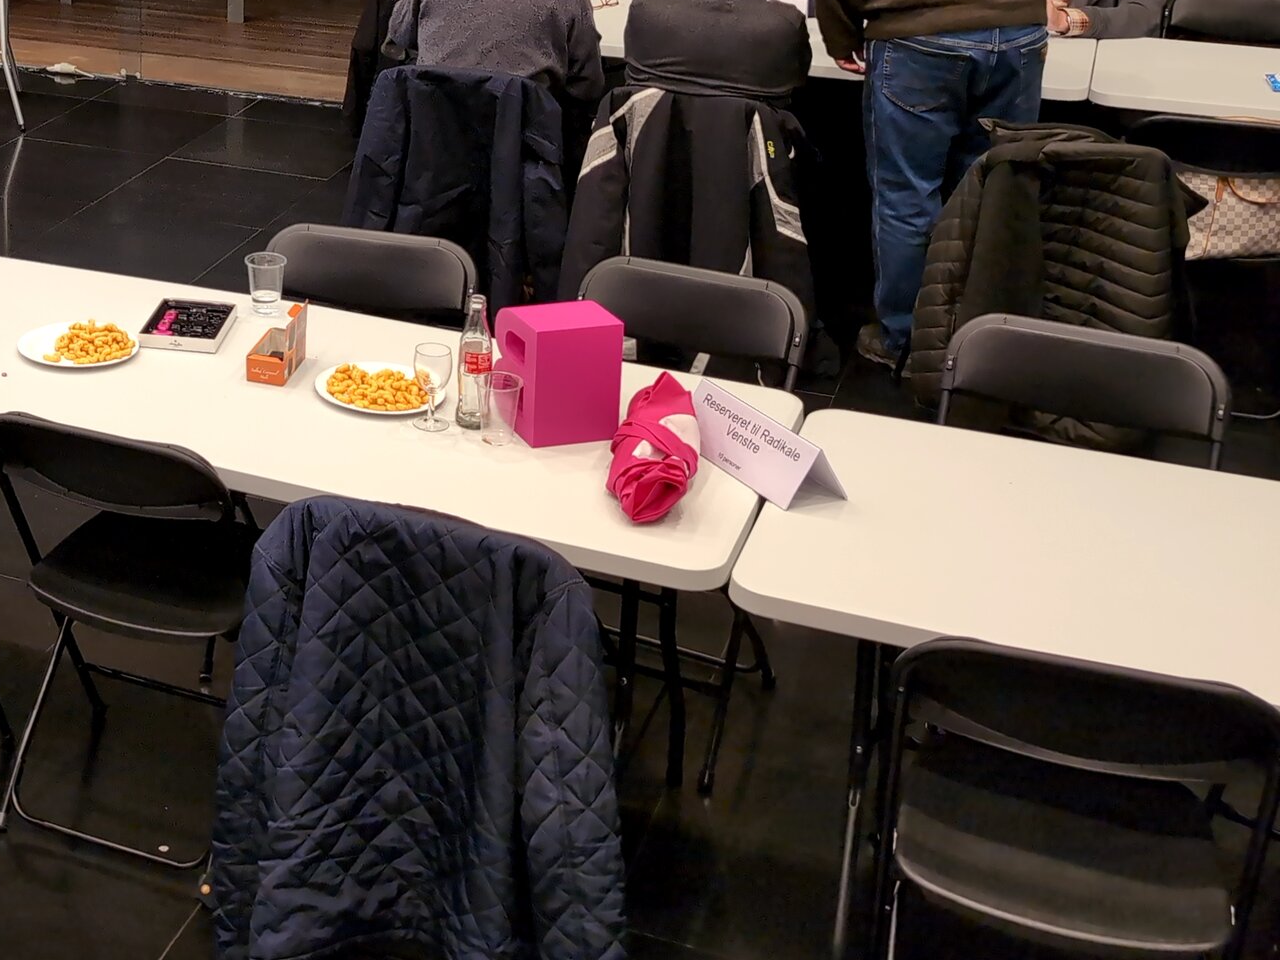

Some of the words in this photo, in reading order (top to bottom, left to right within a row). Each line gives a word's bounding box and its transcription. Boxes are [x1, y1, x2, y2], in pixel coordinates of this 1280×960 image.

[702, 393, 751, 431] Reserveret
[750, 422, 761, 436] til
[760, 429, 801, 462] Radikale
[726, 424, 760, 454] Venstre
